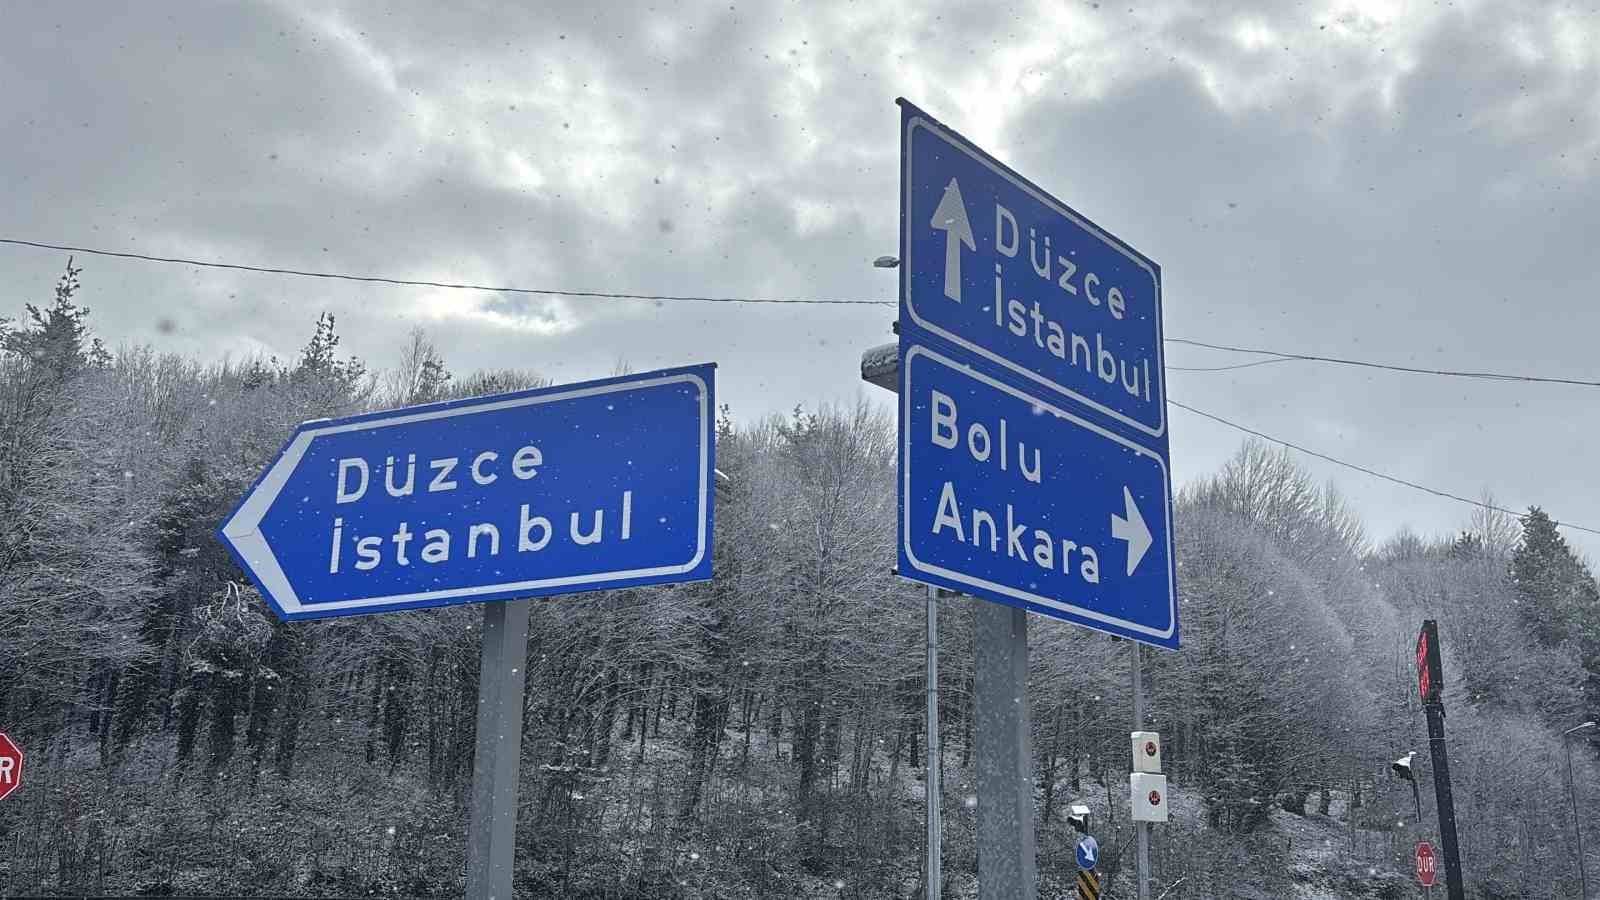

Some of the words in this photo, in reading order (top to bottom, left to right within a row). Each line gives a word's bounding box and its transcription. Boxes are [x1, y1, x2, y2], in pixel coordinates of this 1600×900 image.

[996, 203, 1126, 320] Düzce
[995, 263, 1151, 402] İstanbul
[335, 443, 543, 504] Düzce
[930, 390, 1041, 484] Bolu
[329, 490, 632, 574] İstanbul
[931, 481, 1099, 584] Ankara
[1417, 855, 1435, 873] DUR
